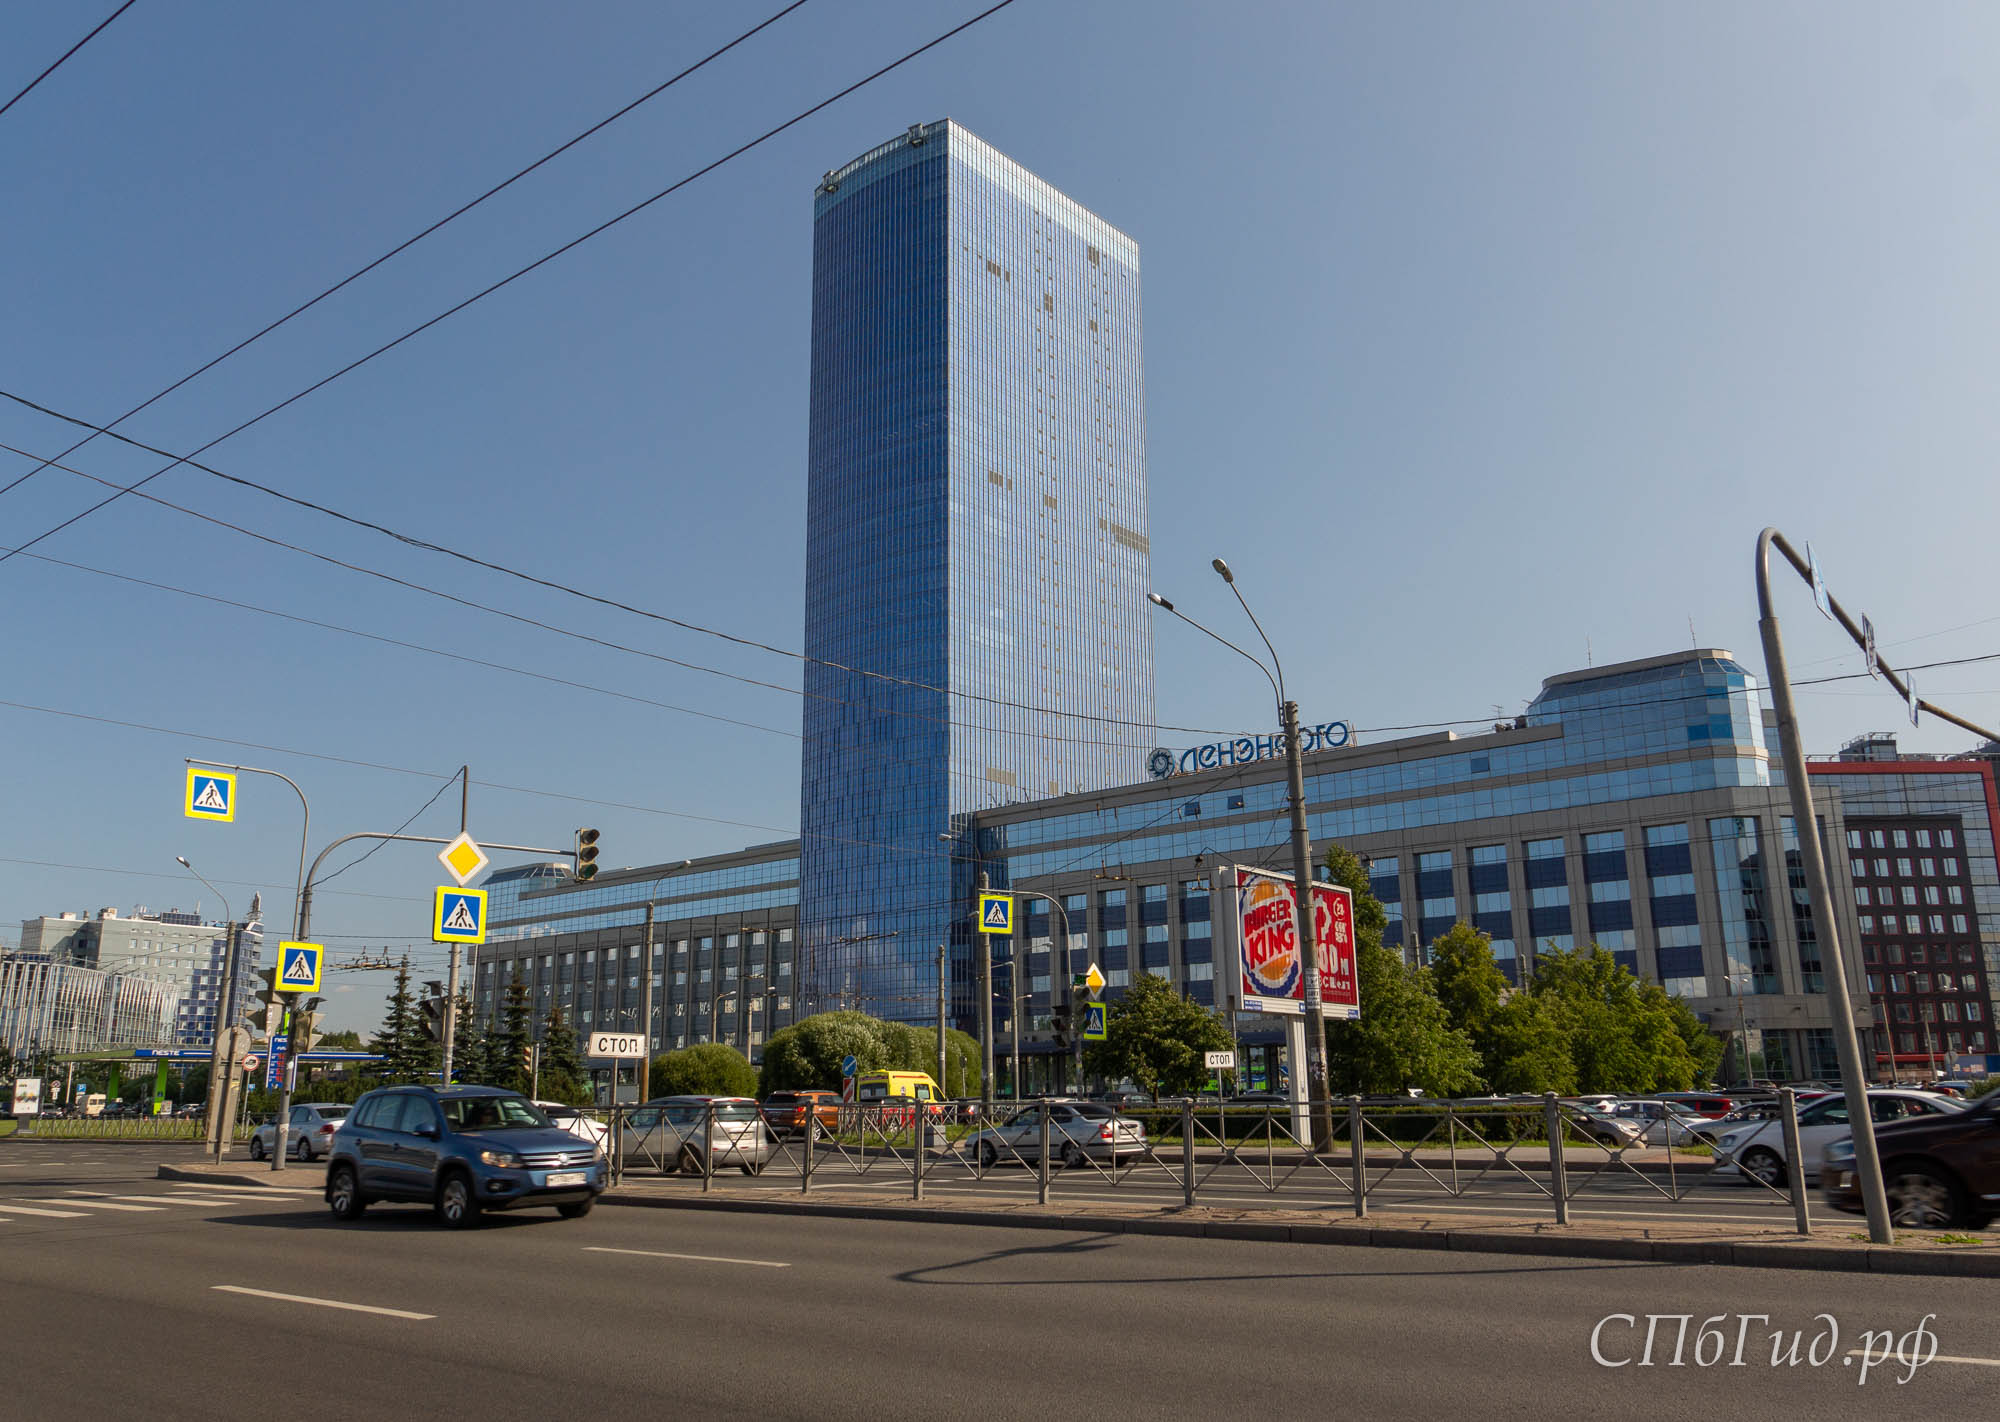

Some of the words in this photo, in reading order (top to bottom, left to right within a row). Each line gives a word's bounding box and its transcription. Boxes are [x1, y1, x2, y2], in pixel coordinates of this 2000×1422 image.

[1244, 899, 1292, 938] BURGER
[1249, 920, 1295, 970] KING
[598, 1037, 638, 1053] СТОП
[1209, 1054, 1231, 1065] СТОП
